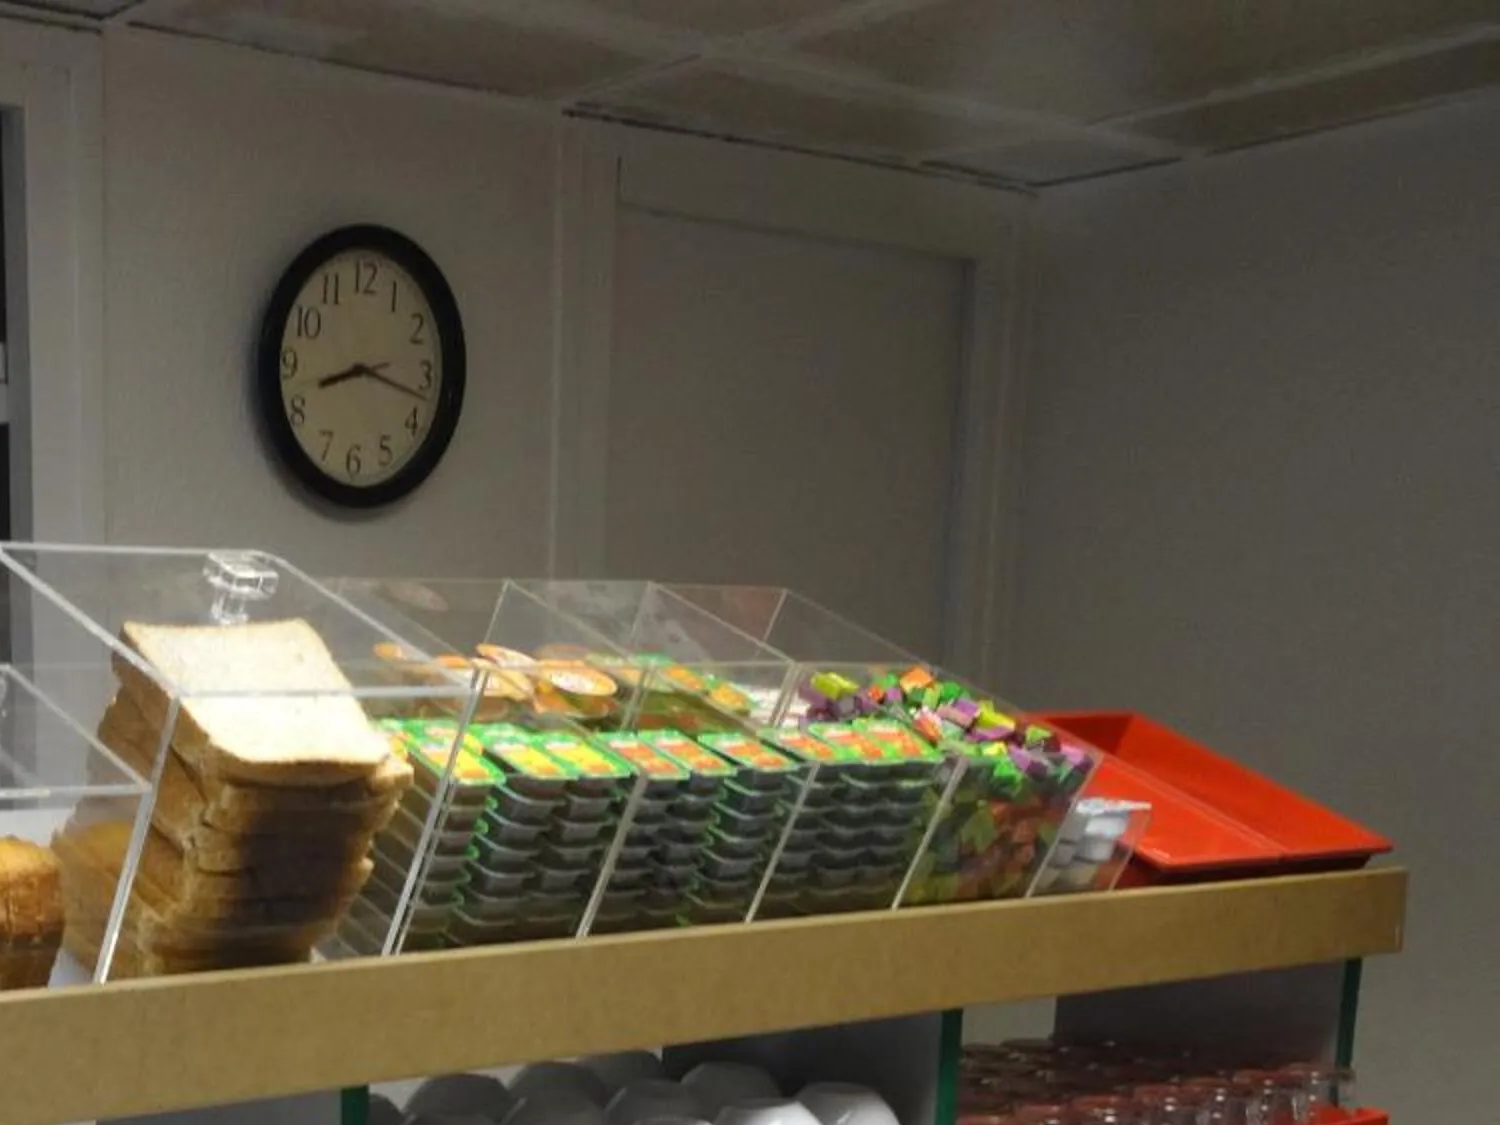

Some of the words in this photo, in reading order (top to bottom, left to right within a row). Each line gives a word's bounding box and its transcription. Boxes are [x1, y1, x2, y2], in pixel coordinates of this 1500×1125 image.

[322, 273, 340, 305] 11
[353, 261, 378, 295] 12
[390, 281, 398, 313] 1
[296, 306, 321, 340] 10
[410, 313, 425, 345] 2
[281, 348, 297, 380] 9
[418, 360, 433, 391] 3
[289, 394, 306, 427] 8
[404, 406, 419, 437] 4
[319, 431, 334, 462] 7
[346, 446, 361, 476] 6
[378, 435, 393, 466] 5
